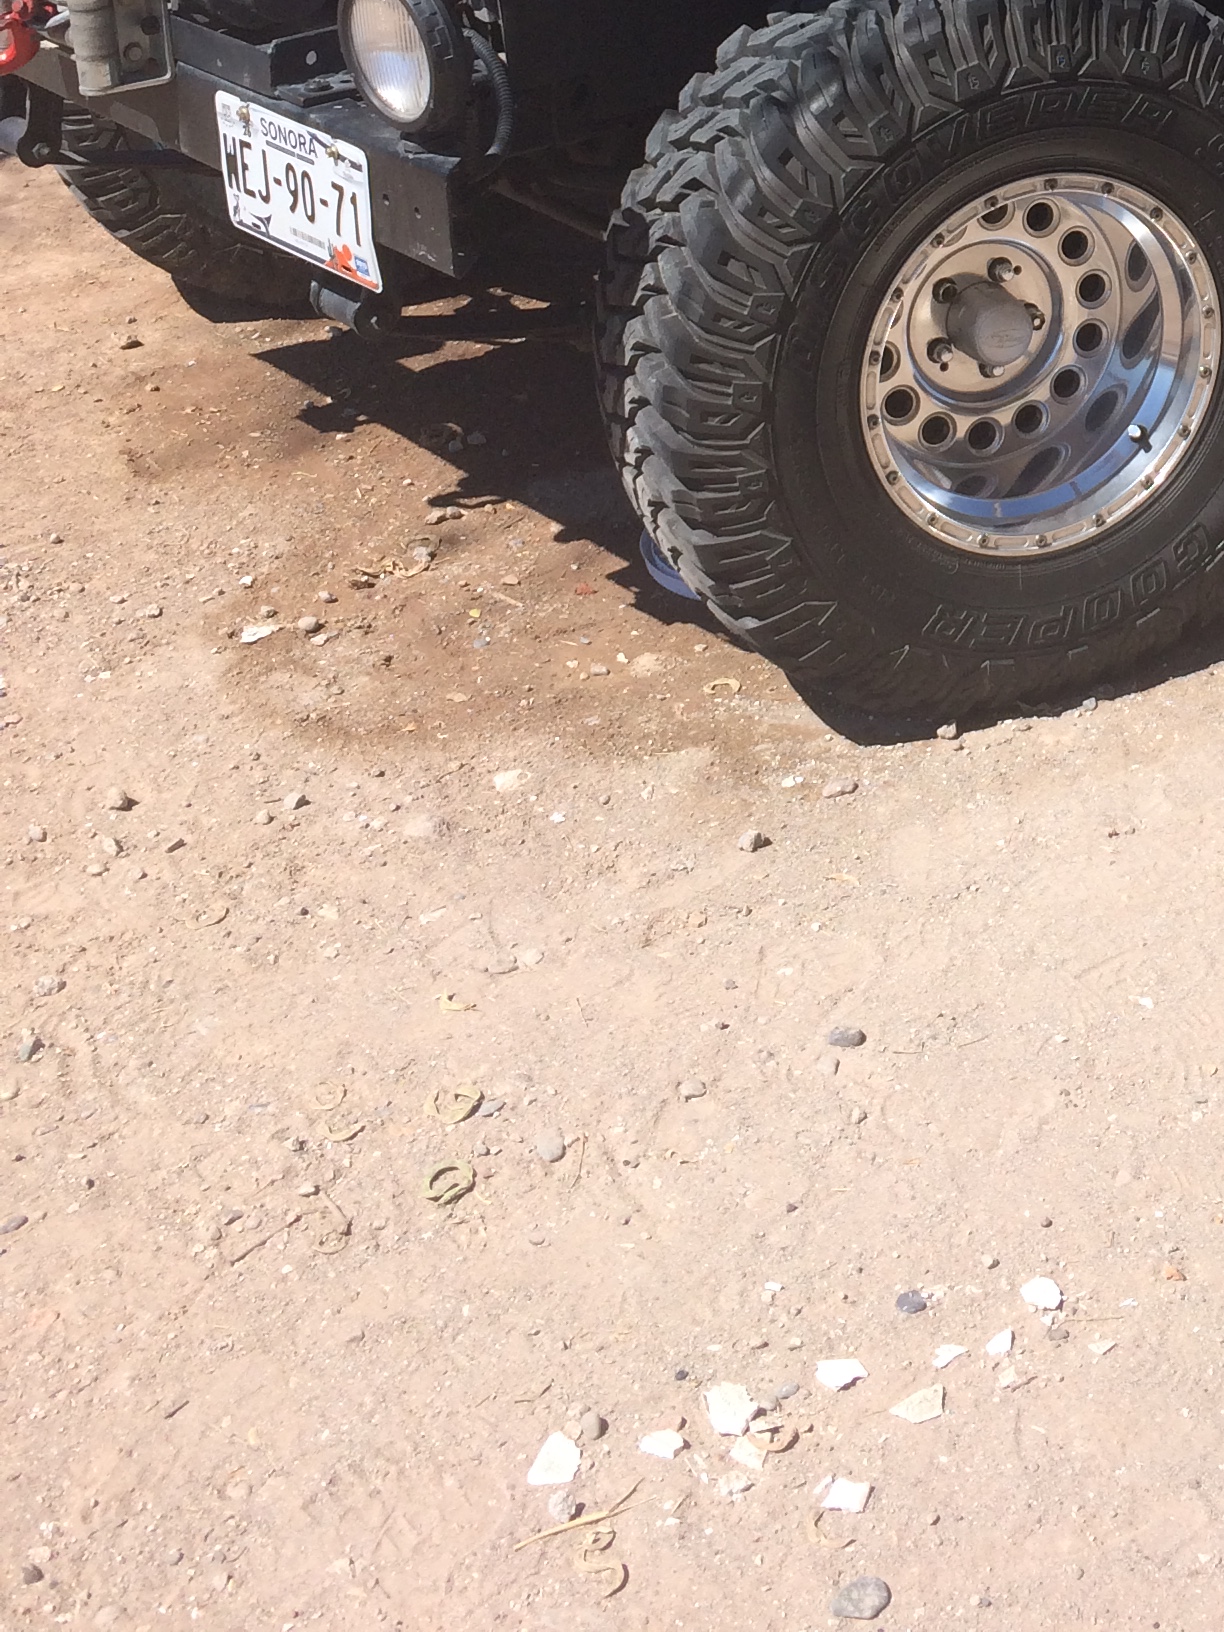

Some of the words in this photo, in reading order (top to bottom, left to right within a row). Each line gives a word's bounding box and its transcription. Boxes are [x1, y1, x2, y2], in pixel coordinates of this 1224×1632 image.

[222, 132, 362, 247] WEJ-90-71
[259, 117, 319, 159] SONORA
[920, 519, 1221, 646] COOPER
